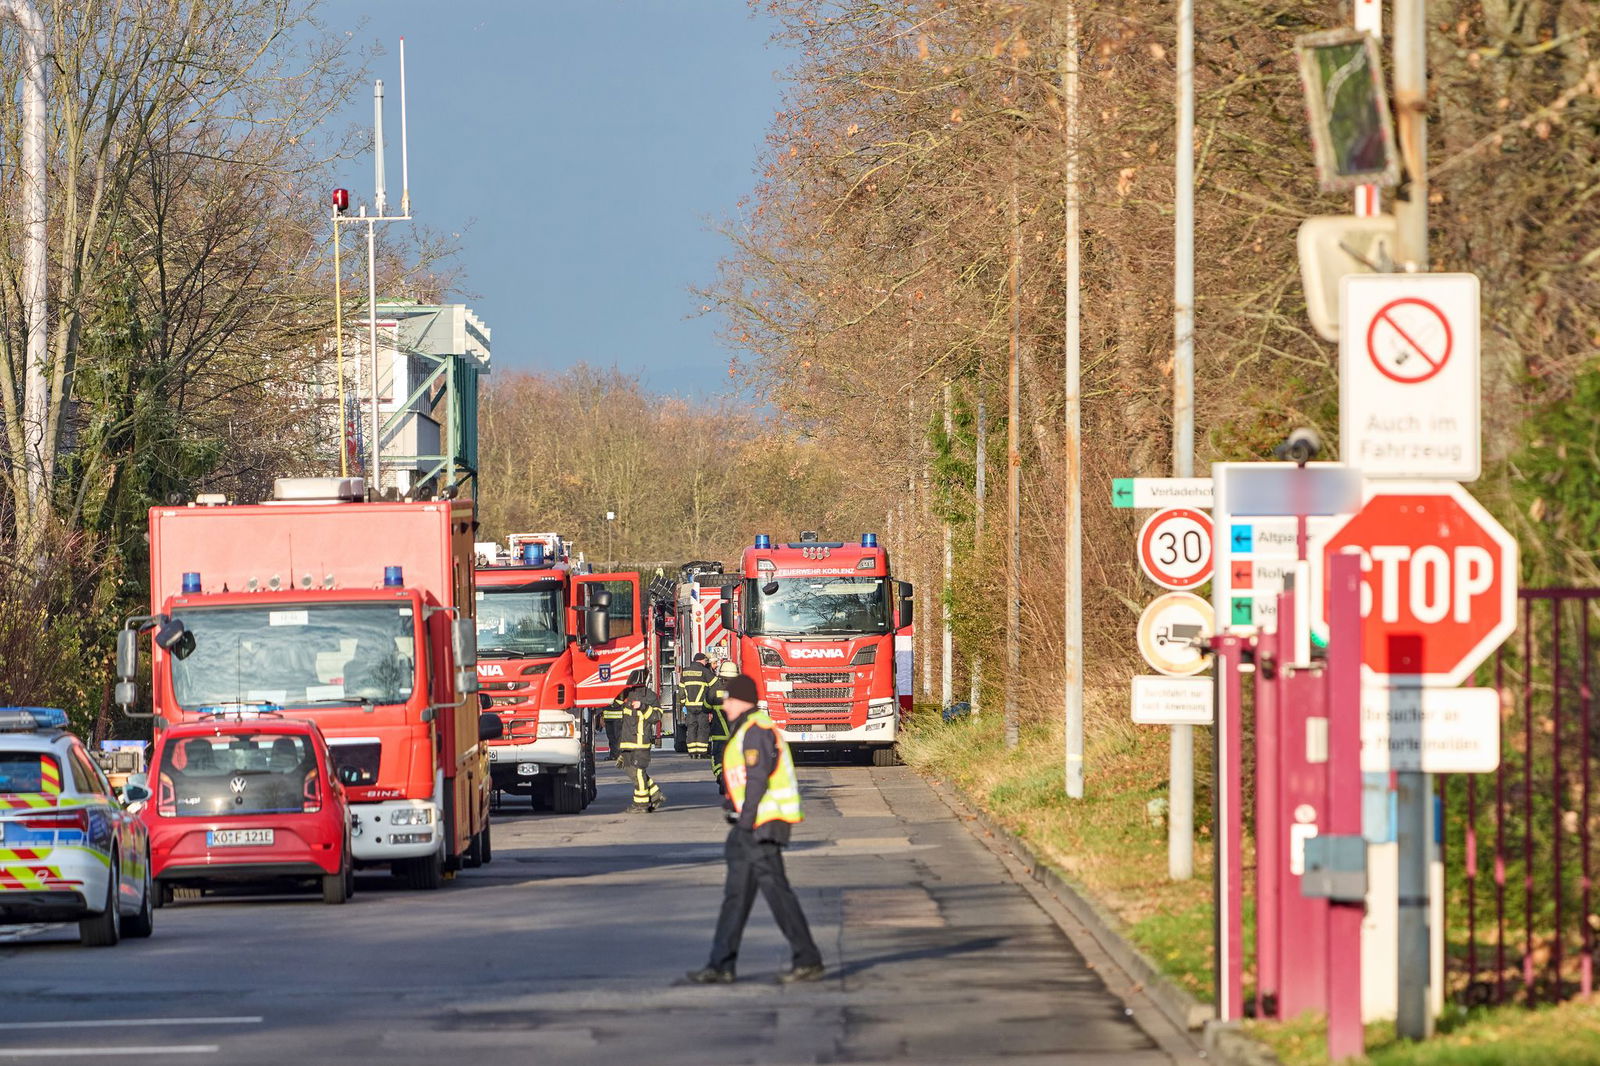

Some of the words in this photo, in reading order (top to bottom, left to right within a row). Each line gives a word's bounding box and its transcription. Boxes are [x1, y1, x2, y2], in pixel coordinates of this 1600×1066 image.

[1365, 412, 1422, 432] Auch
[1429, 412, 1458, 432] im
[1359, 439, 1462, 464] Fahrzeug
[1158, 530, 1202, 565] 30
[779, 568, 821, 576] FEUERWEHR
[822, 567, 855, 575] KOBLENZ
[790, 648, 845, 659] SCANIA
[476, 664, 504, 676] NIA
[367, 789, 401, 798] BINZ
